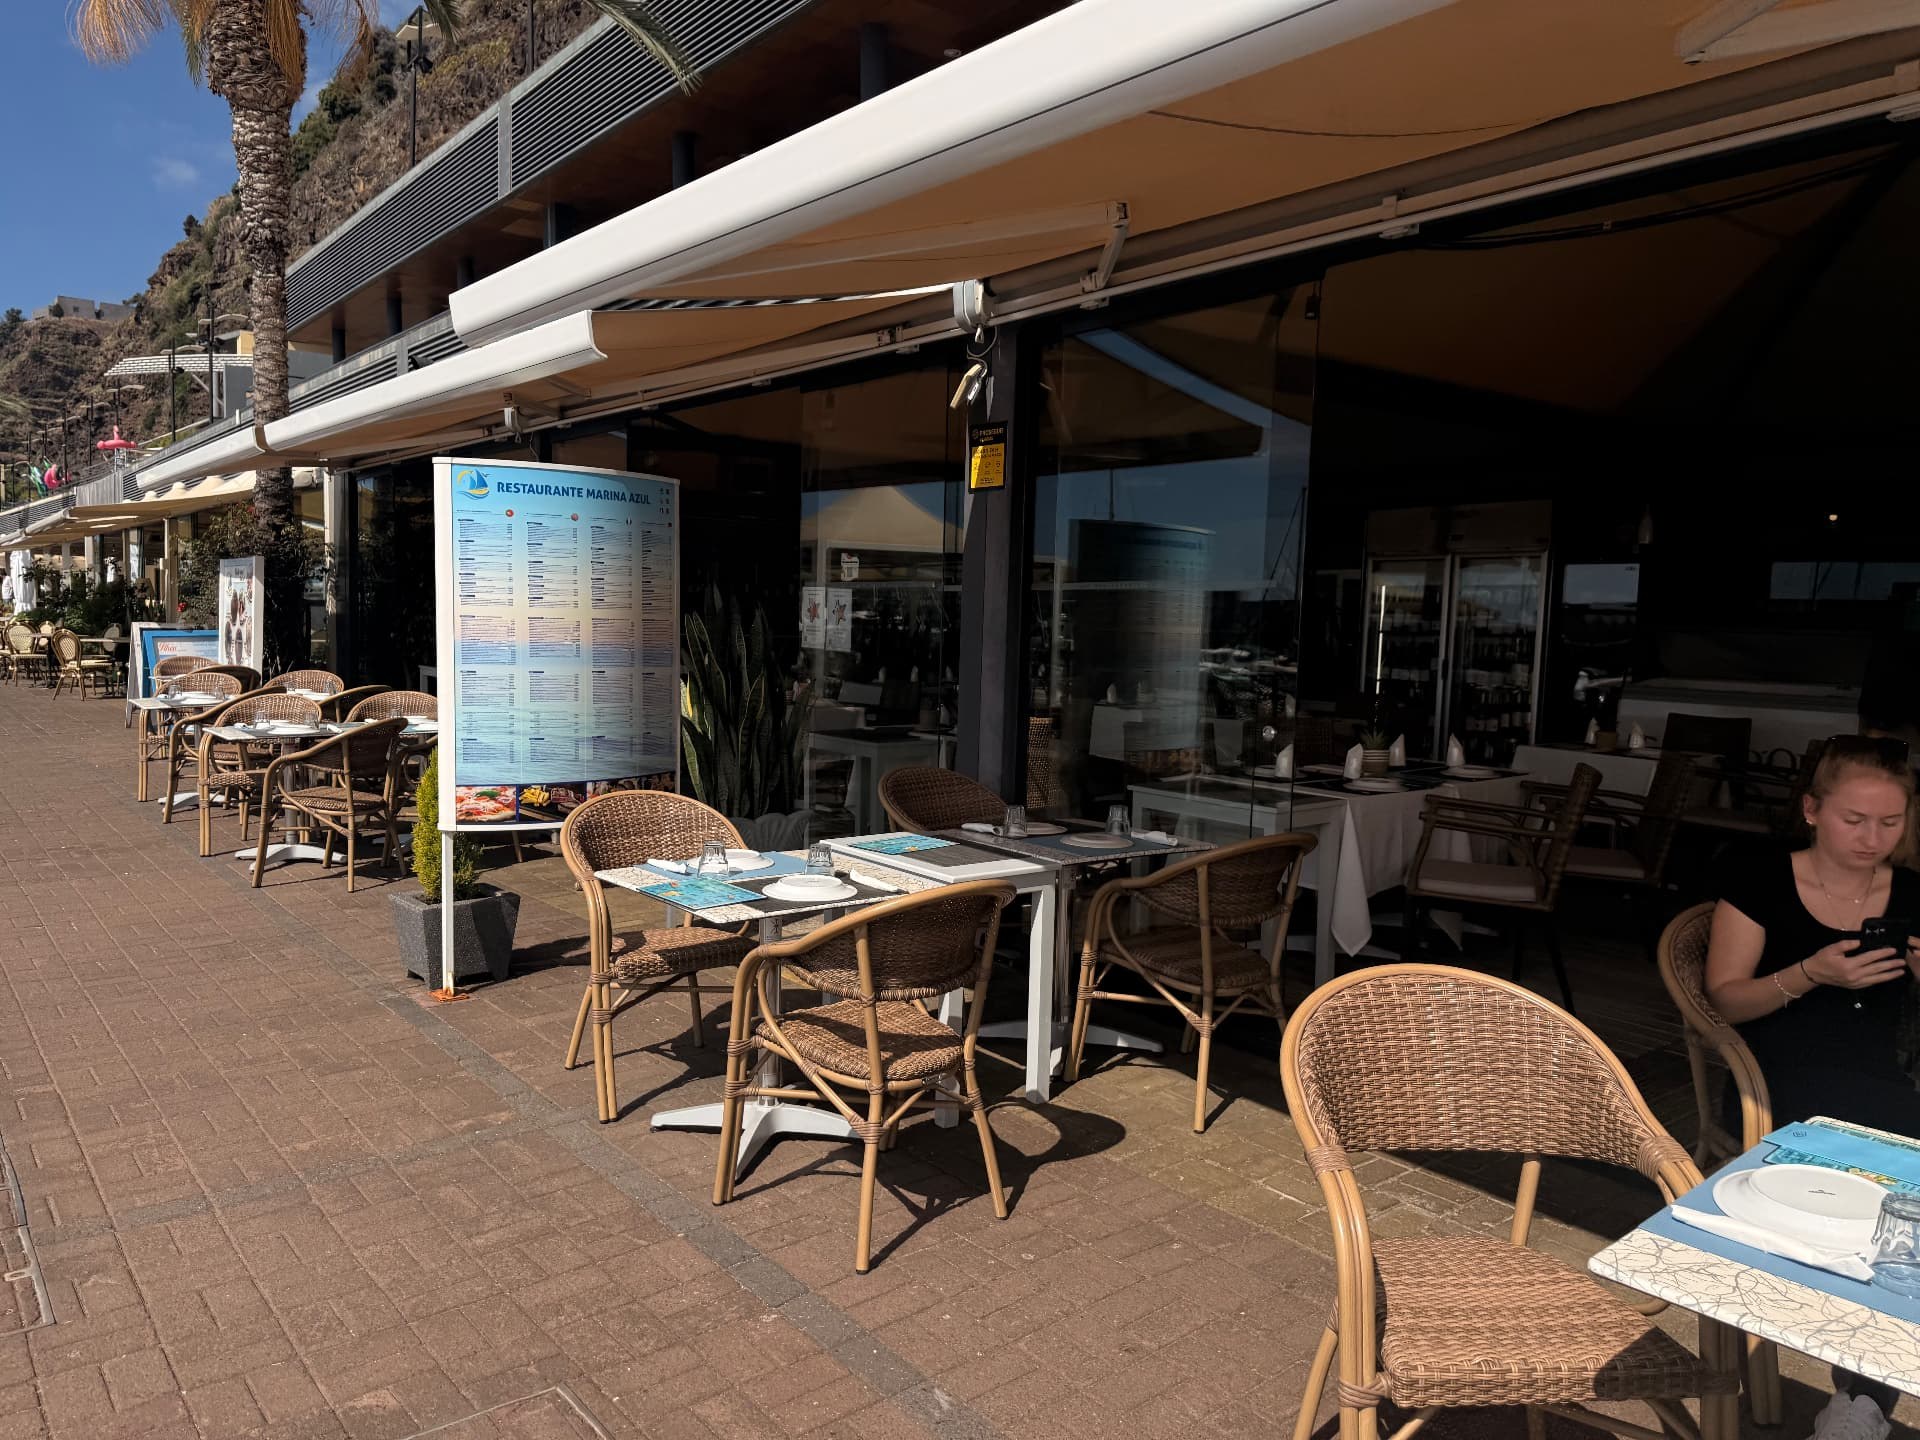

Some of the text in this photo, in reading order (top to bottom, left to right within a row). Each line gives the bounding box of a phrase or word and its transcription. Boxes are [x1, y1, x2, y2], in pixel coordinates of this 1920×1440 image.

[497, 481, 651, 505] RESTAURANTE MARINA AZUL
